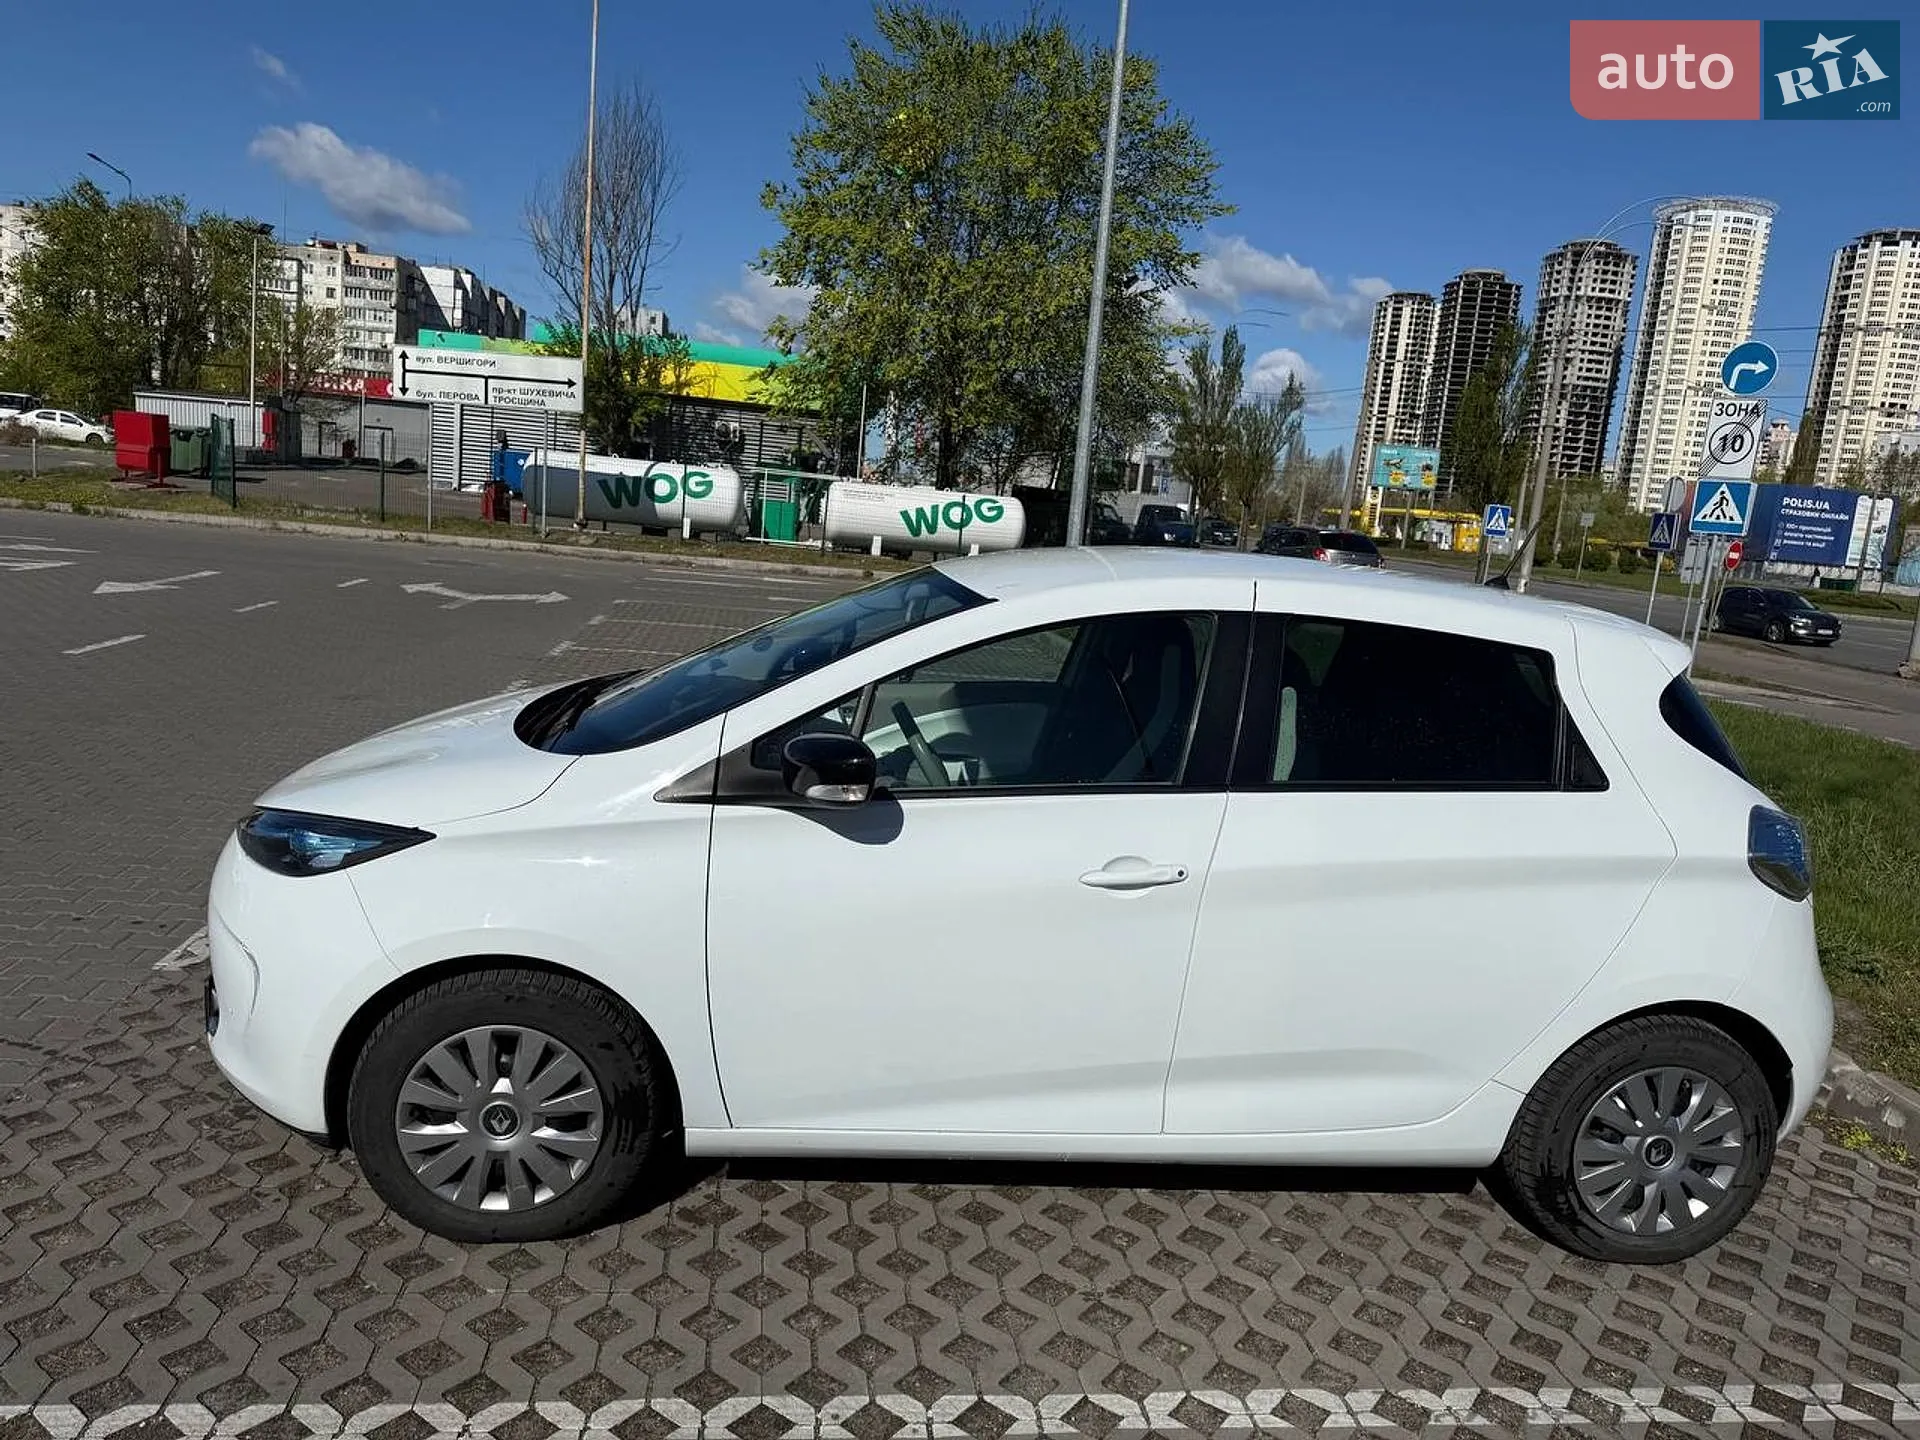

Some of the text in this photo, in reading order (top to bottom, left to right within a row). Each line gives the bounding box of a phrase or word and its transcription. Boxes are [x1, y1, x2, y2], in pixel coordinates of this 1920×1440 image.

[436, 355, 496, 368] ВЕРШИГОРИ
[439, 391, 481, 401] ПЕРОВА
[519, 388, 576, 399] ШУХЕВИЧА
[1714, 402, 1761, 418] ЗОНА
[597, 471, 714, 509] WOG
[1782, 496, 1830, 510] POLIS.UA
[900, 498, 1004, 538] WOG
